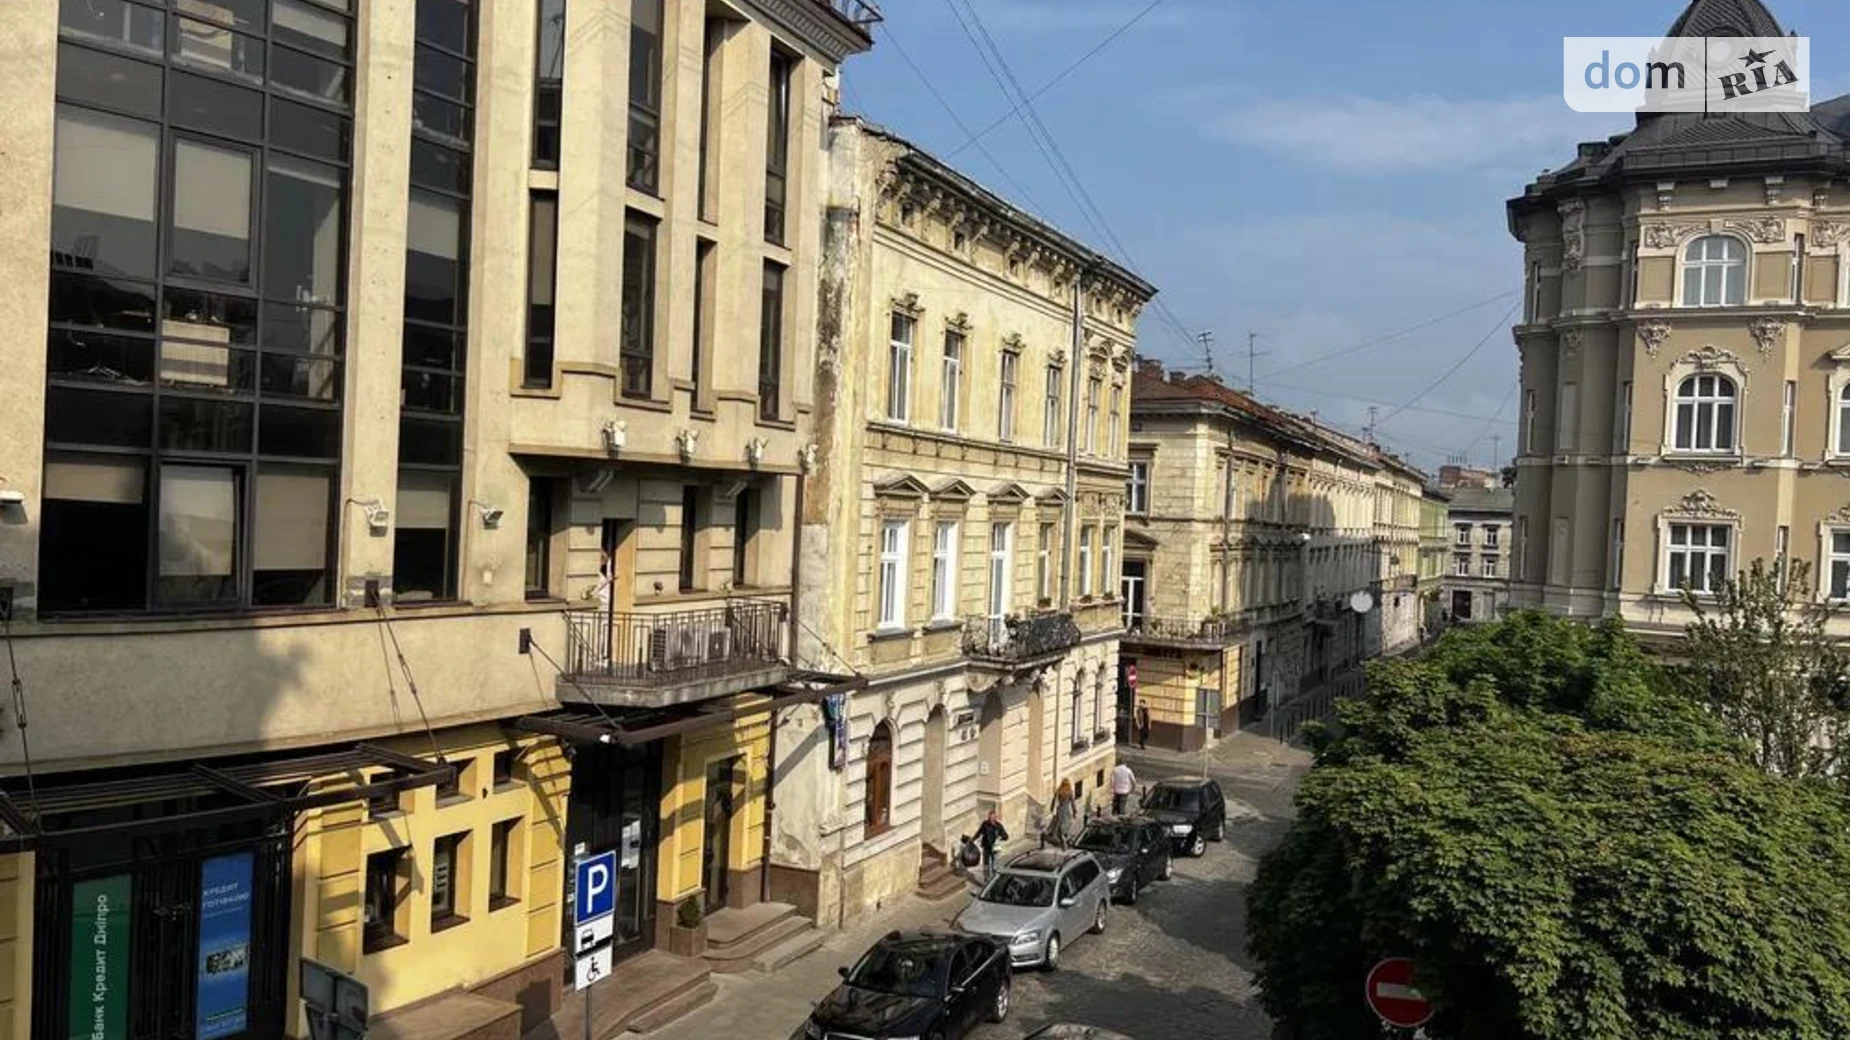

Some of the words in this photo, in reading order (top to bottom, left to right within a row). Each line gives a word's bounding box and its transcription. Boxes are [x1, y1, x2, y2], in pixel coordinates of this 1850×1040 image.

[587, 863, 609, 914] P
[94, 894, 110, 946] Дніпро
[92, 949, 107, 1002] Кредит
[92, 1005, 105, 1040] Банк
